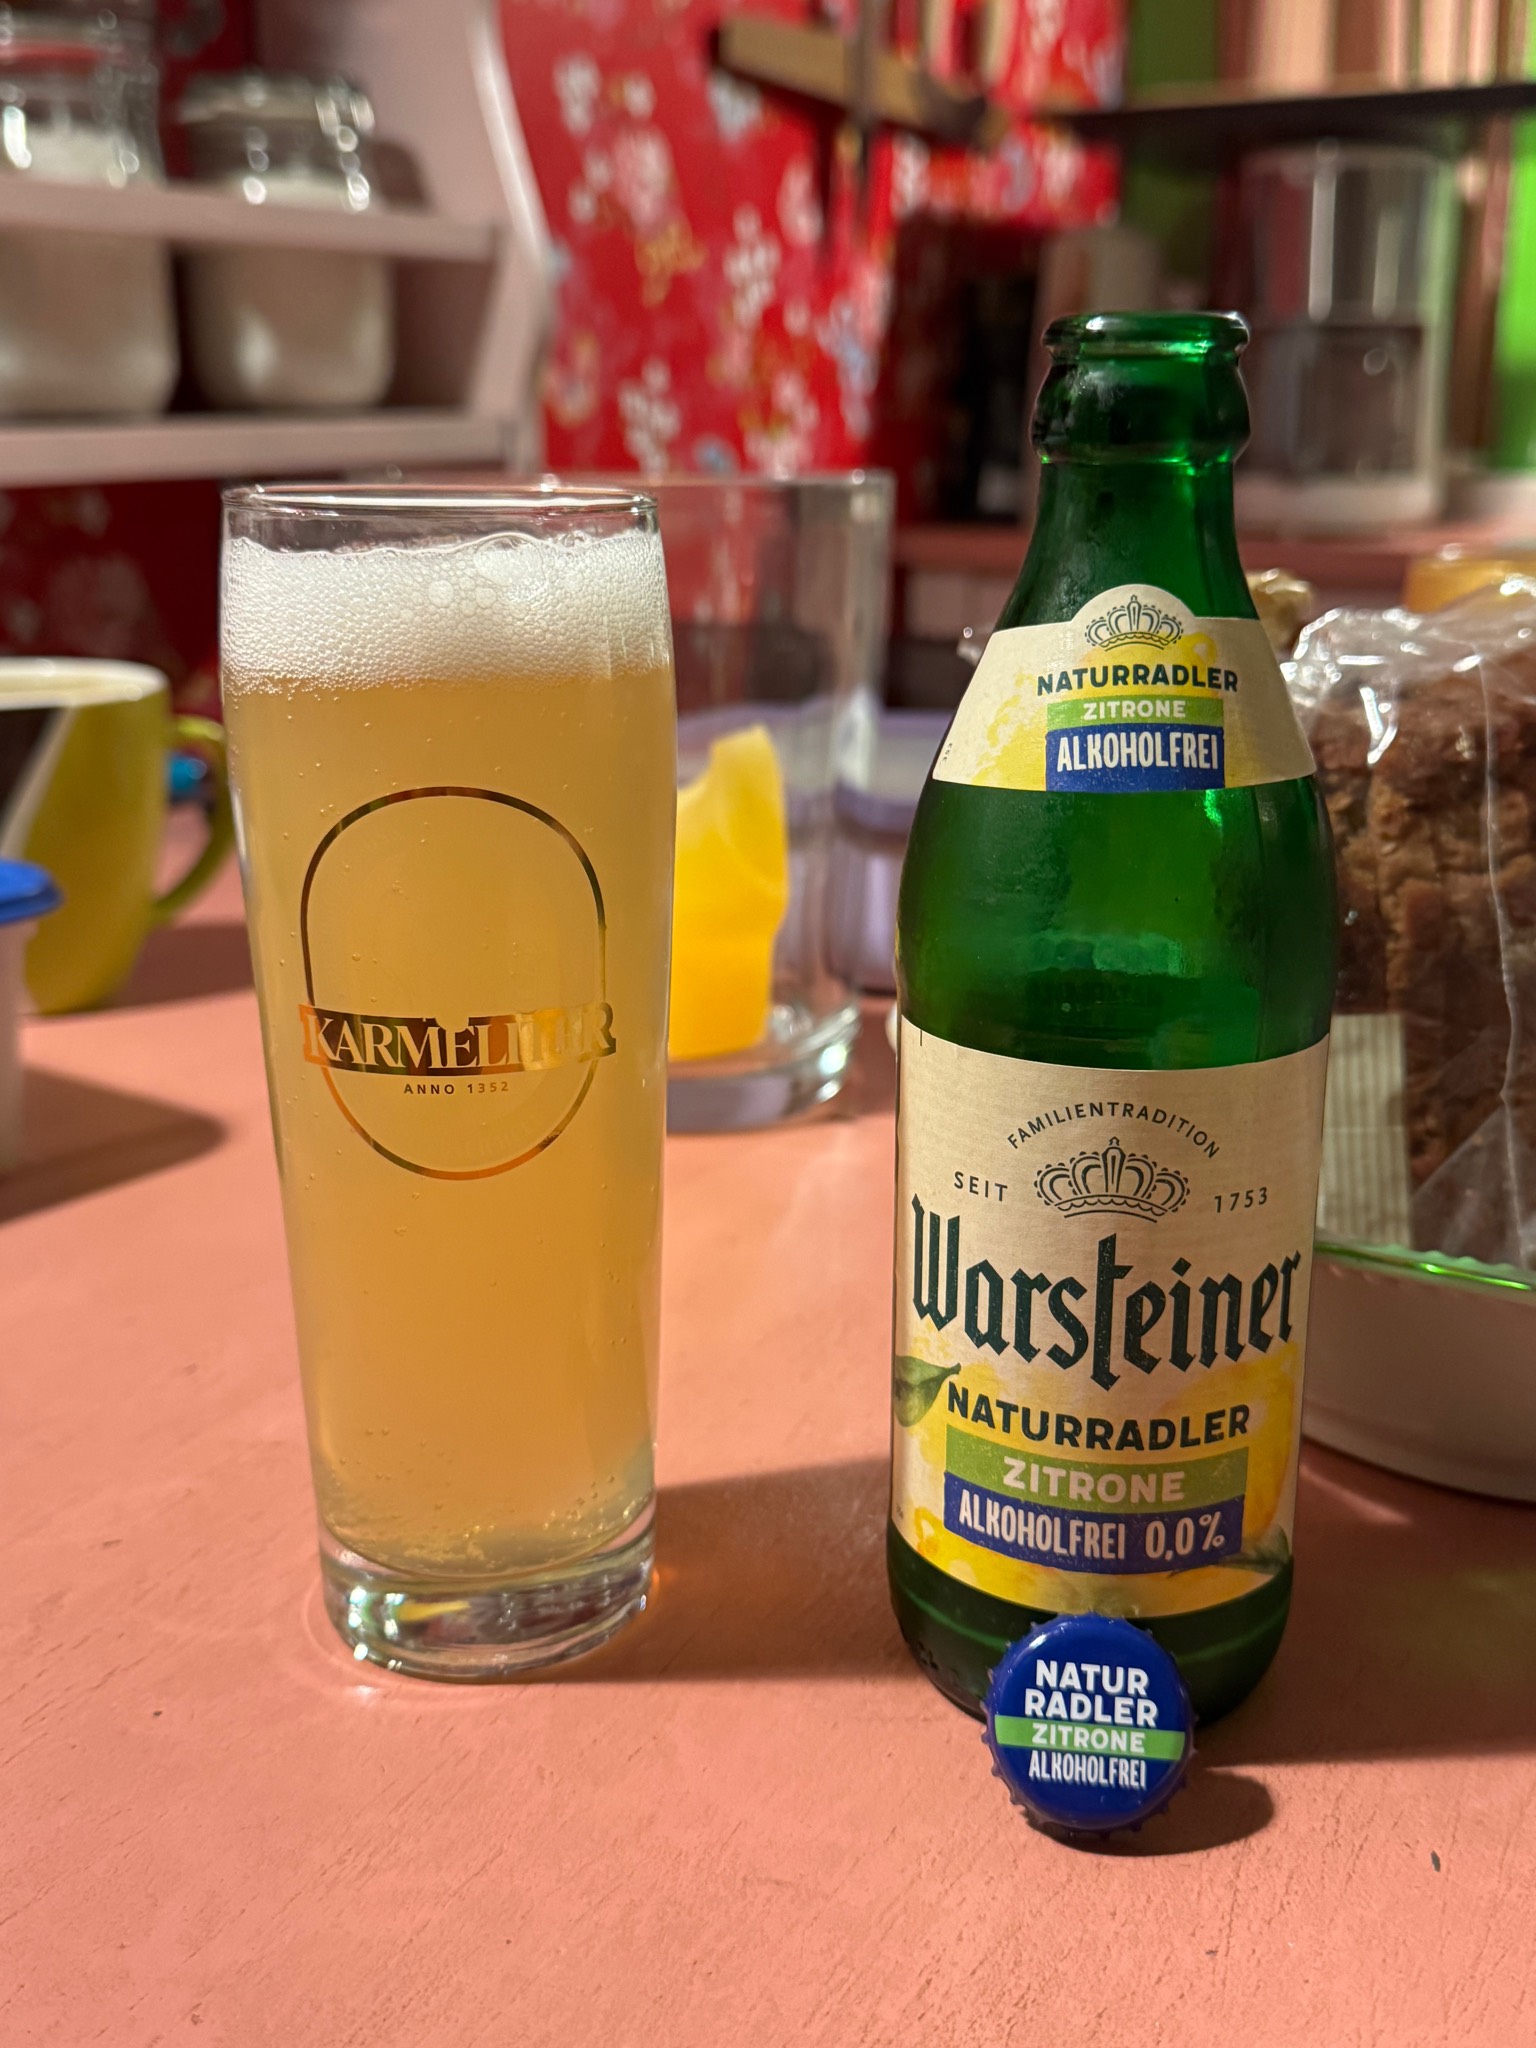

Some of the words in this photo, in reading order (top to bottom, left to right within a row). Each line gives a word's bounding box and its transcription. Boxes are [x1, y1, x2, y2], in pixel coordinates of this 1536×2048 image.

[1036, 664, 1238, 696] NATURRADLER
[1083, 699, 1187, 721] ZITRONE
[1056, 731, 1219, 773] ALKOHOLFREI
[403, 1082, 456, 1096] ANNO
[466, 1080, 510, 1095] 1352
[1007, 1101, 1220, 1159] FAMILIENTRADITION
[953, 1170, 1008, 1202] SEIT
[1213, 1186, 1269, 1214] 1753
[911, 1193, 1301, 1391] Warsteiner
[947, 1381, 1250, 1452] NATURRADLER
[1002, 1456, 1186, 1504] ZITRONE
[958, 1489, 1126, 1560] ALKOHOLFREI
[1035, 1659, 1150, 1697] NATUR
[1024, 1688, 1158, 1728] RADLER
[1031, 1722, 1147, 1754] ZITRONE
[1028, 1750, 1147, 1790] ALKOHOLFREI
